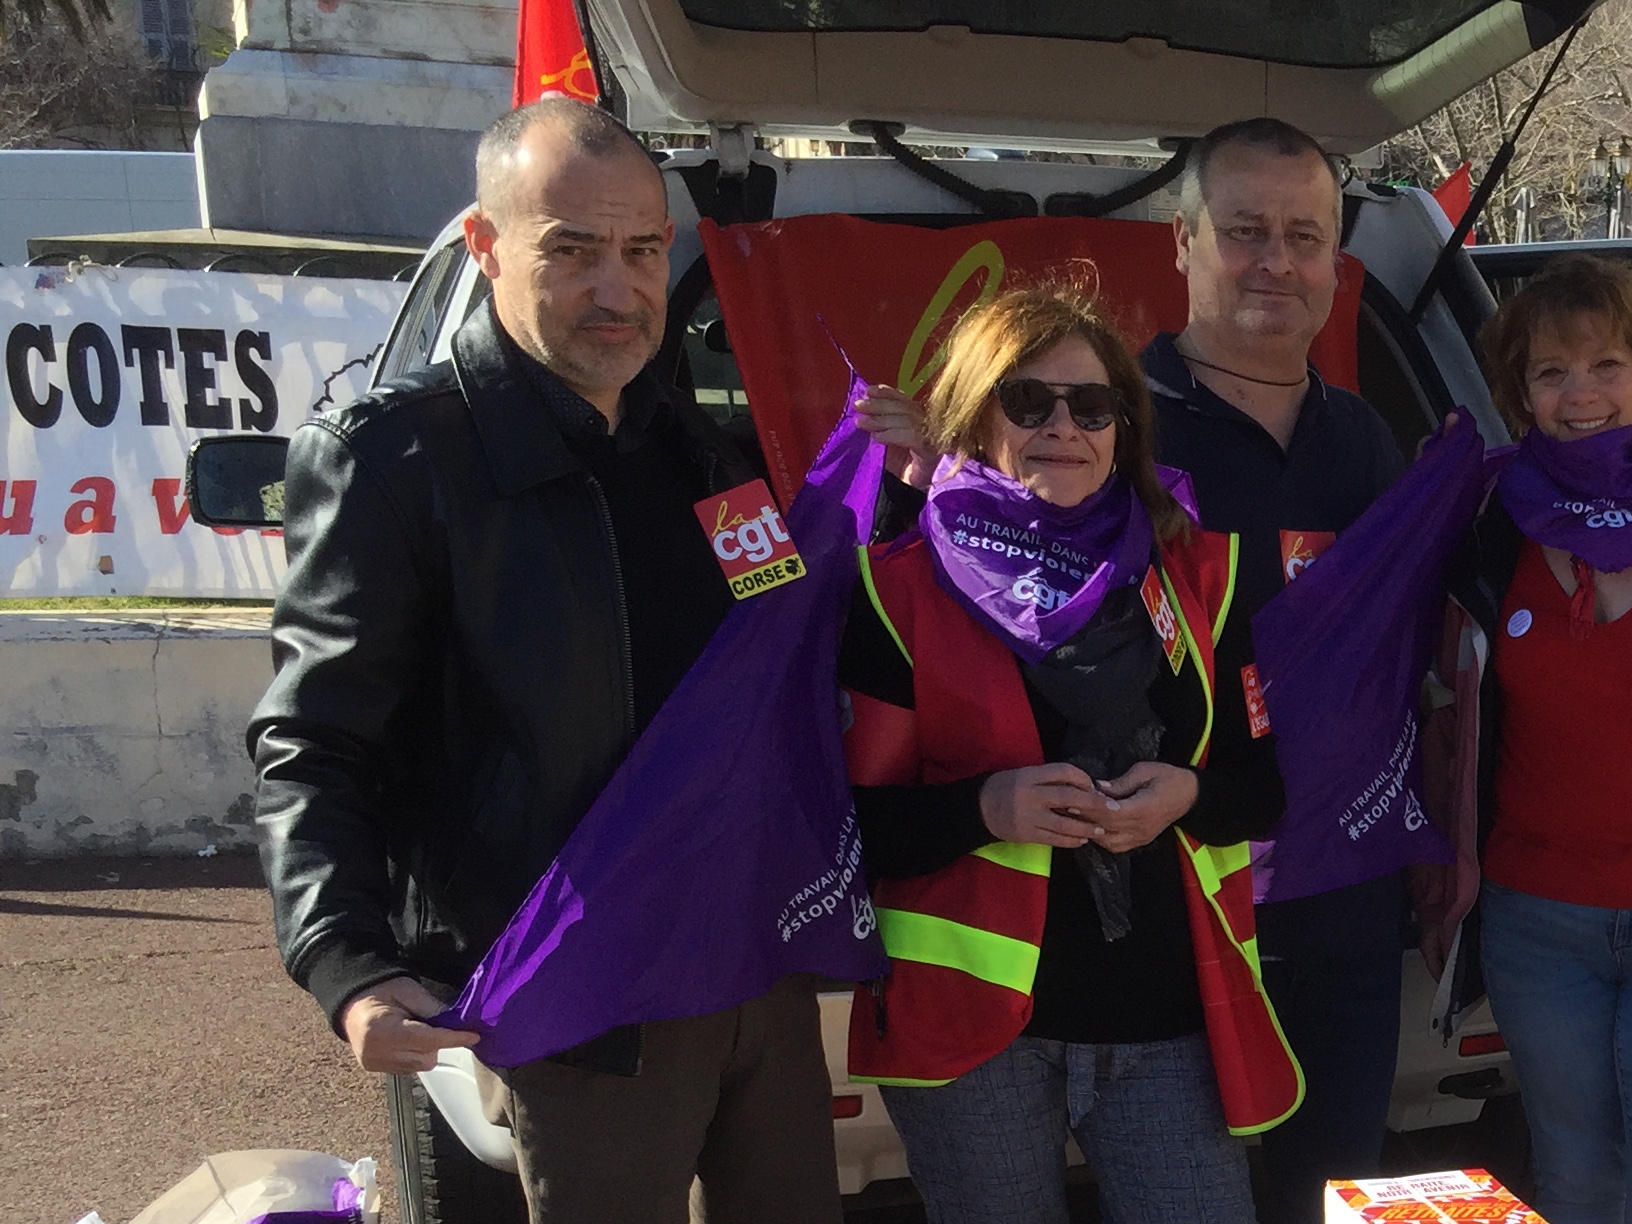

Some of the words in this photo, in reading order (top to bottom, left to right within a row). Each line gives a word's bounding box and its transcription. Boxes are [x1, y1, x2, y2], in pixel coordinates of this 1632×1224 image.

[6, 322, 279, 432] COTES
[713, 505, 790, 563] cgt
[956, 512, 978, 530] AU
[732, 563, 786, 596] CORSE
[1338, 809, 1353, 827] AU
[777, 908, 790, 930] AU
